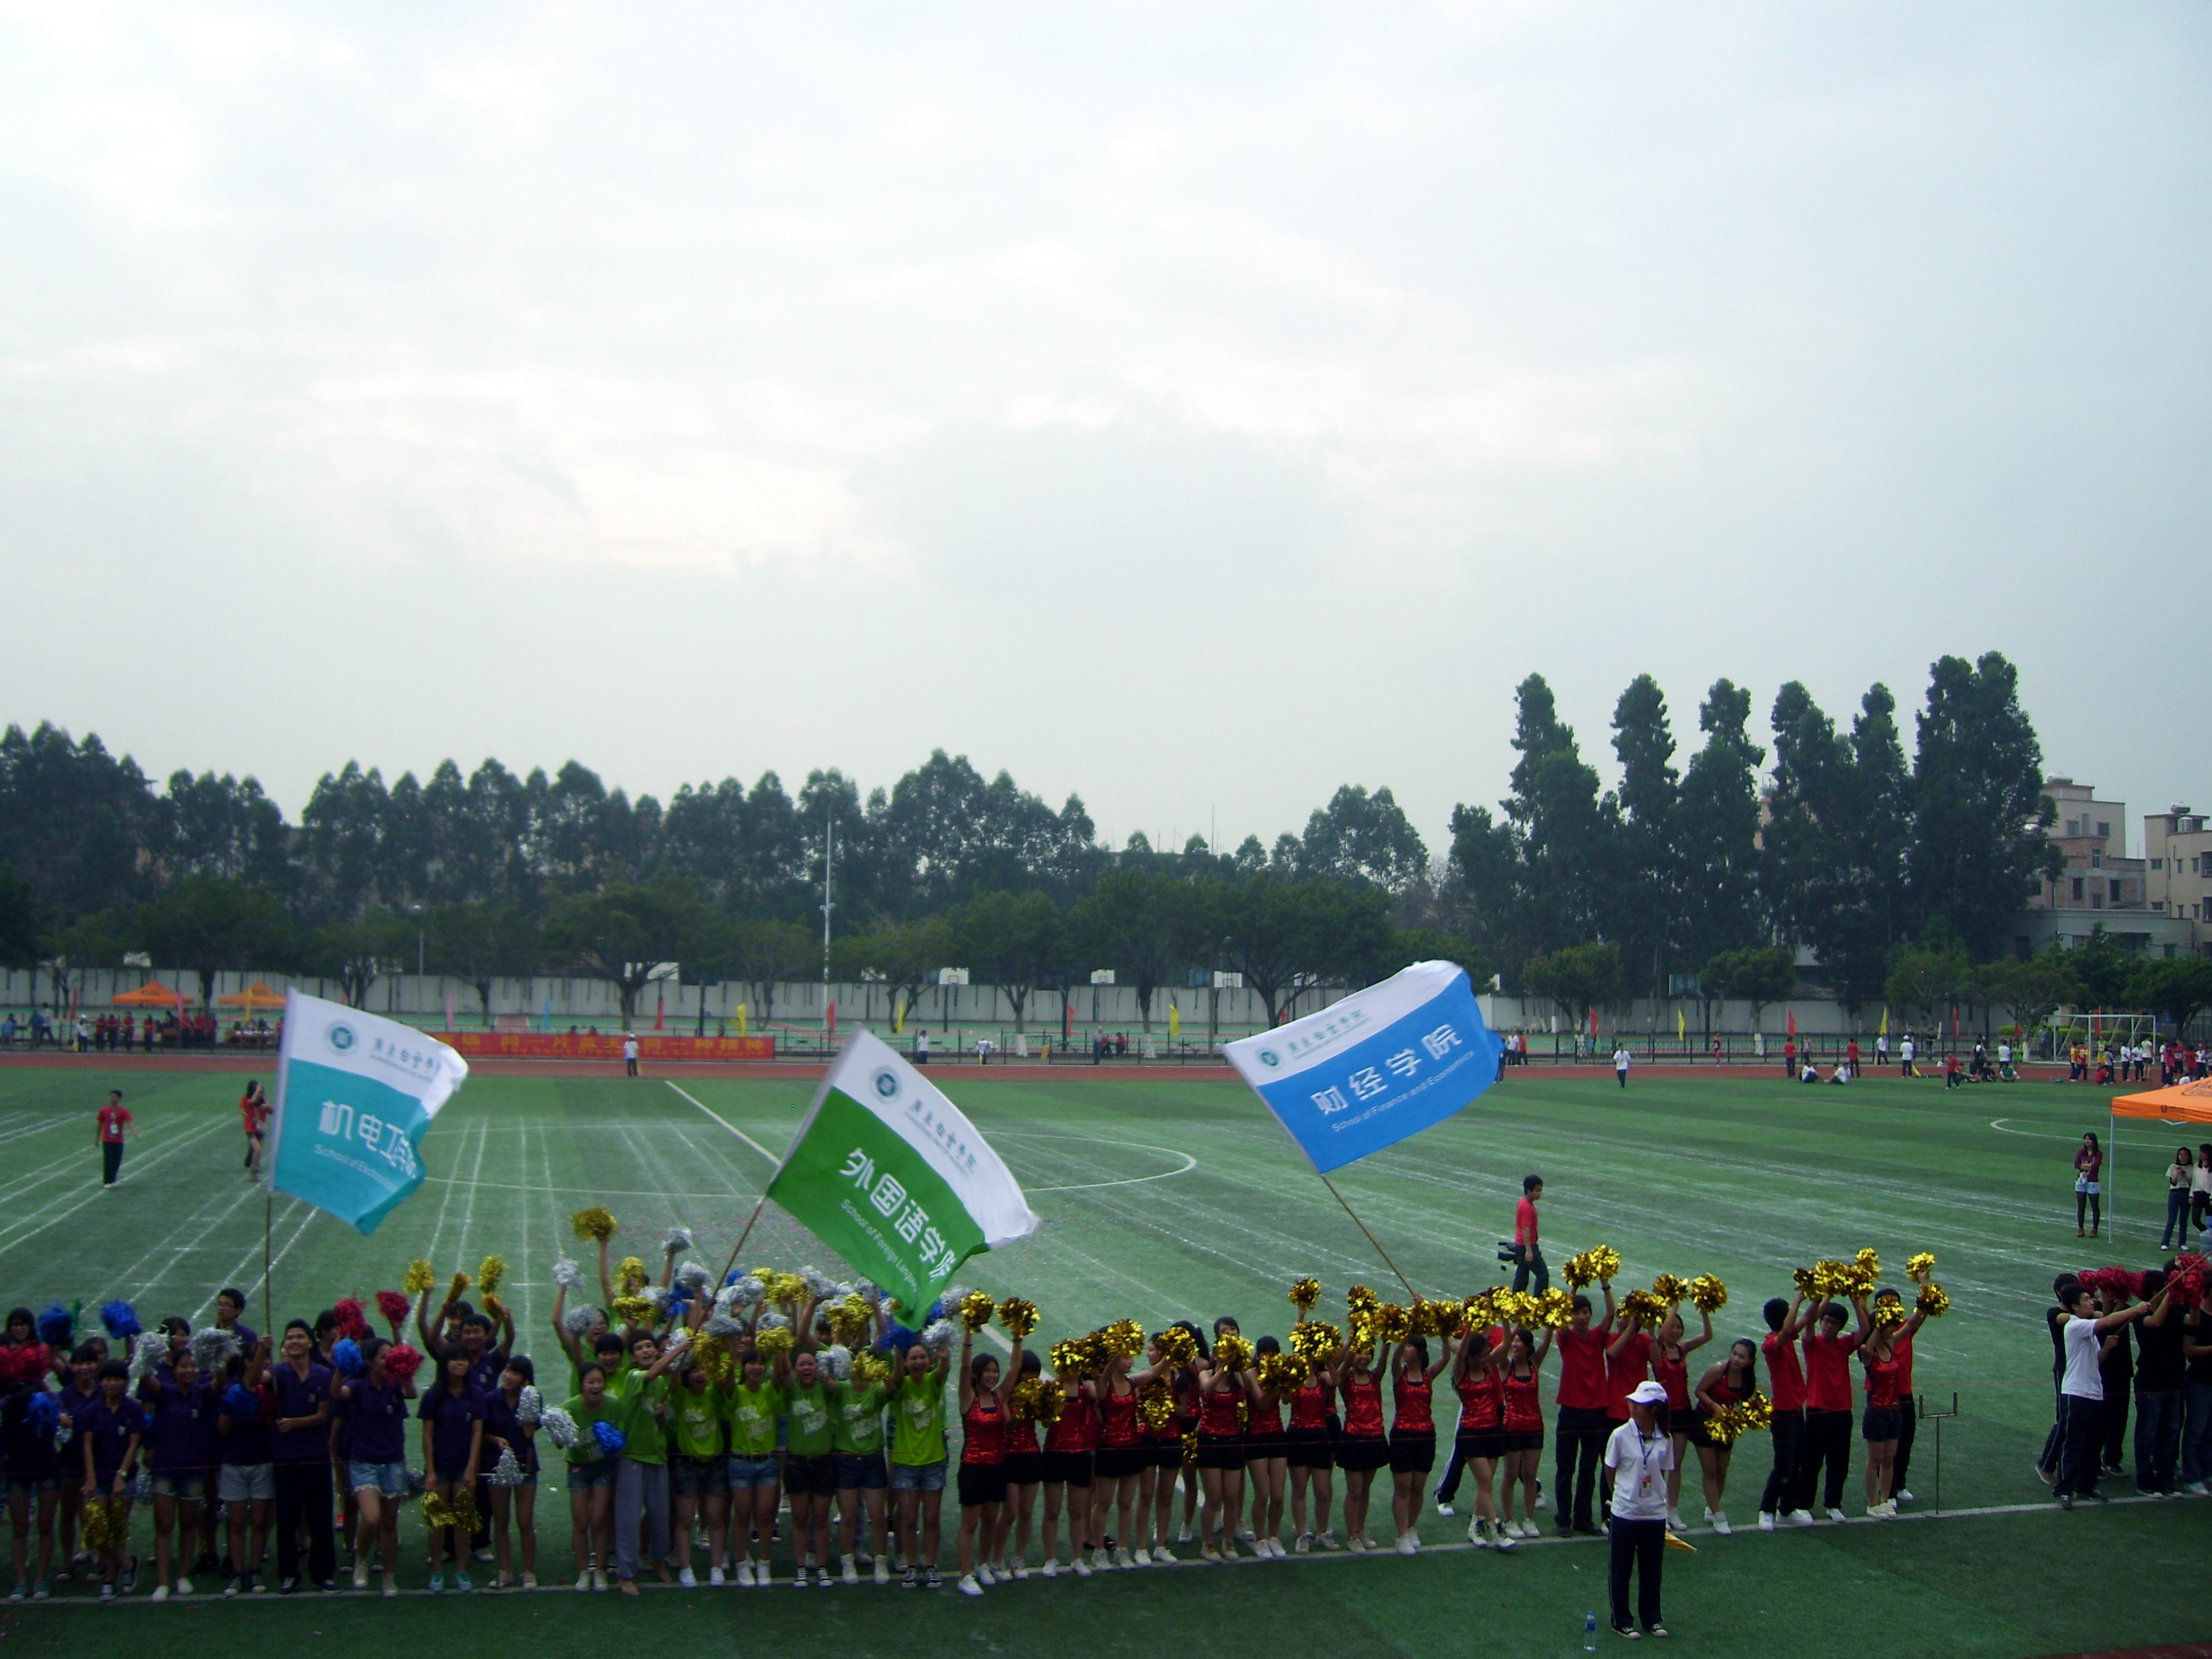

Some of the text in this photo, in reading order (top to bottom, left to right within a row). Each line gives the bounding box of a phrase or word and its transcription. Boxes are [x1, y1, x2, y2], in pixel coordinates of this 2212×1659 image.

[1310, 1023, 1463, 1116] 财经学院
[841, 1199, 869, 1228] School
[865, 1225, 878, 1236] of
[873, 1233, 899, 1263] Foreign
